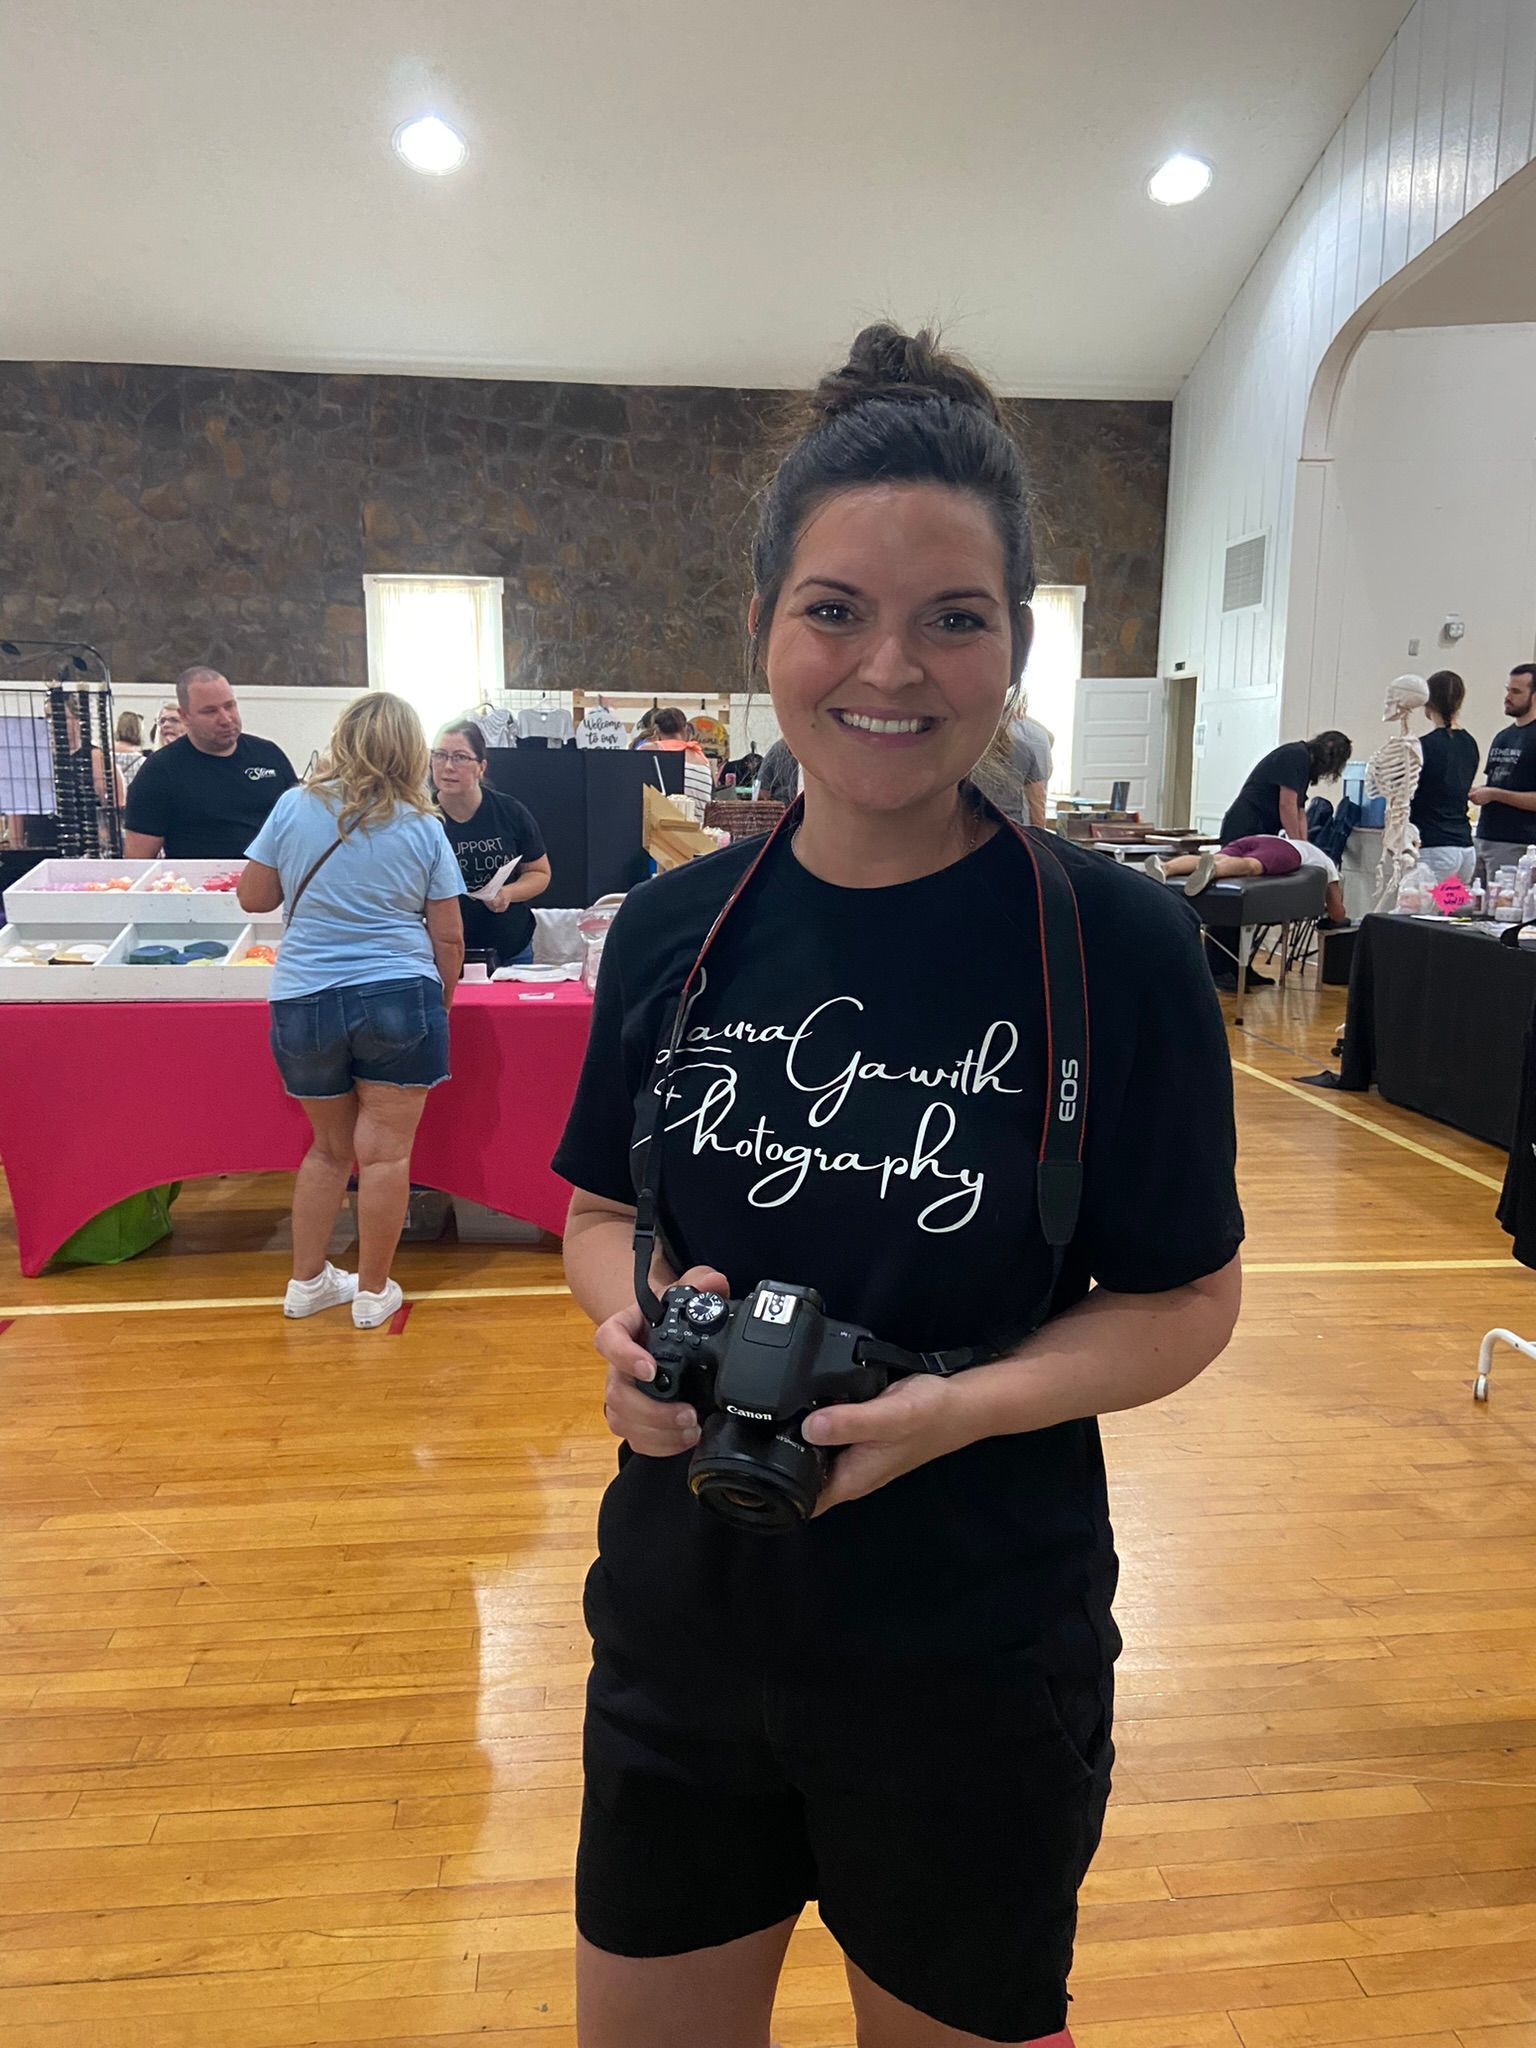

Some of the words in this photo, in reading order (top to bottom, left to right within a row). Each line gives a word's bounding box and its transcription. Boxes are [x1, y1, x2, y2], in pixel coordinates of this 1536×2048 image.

[583, 718, 622, 731] Welcome
[585, 732, 598, 745] to
[600, 734, 618, 745] our
[786, 996, 1023, 1127] Gawith
[1058, 1058, 1079, 1122] EOS
[726, 1405, 772, 1420] Canon
